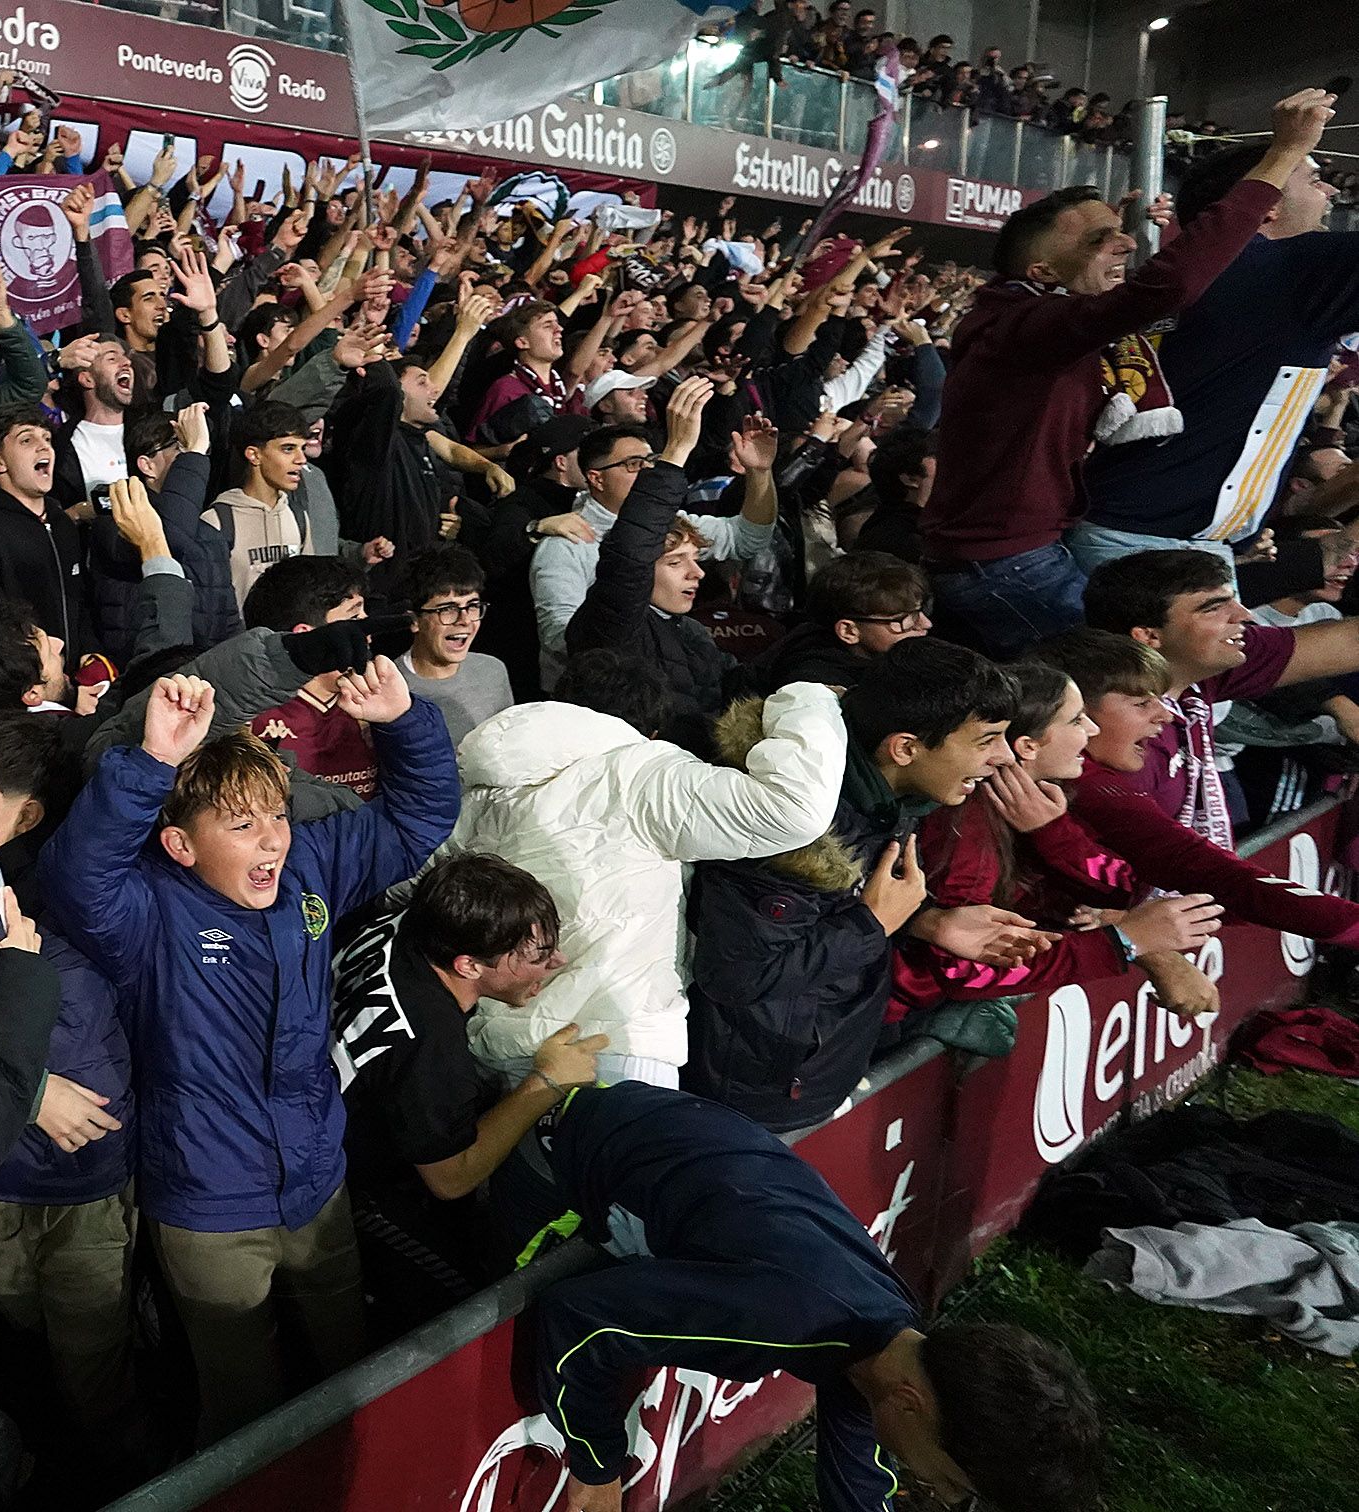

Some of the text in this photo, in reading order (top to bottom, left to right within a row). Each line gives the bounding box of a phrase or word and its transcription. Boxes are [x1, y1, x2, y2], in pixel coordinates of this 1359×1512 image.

[117, 44, 326, 101] Pontevedra Viva Radio
[541, 103, 644, 170] Galicia
[732, 142, 820, 198] Estrella
[248, 545, 289, 565] PUMA
[202, 943, 230, 951] umbro
